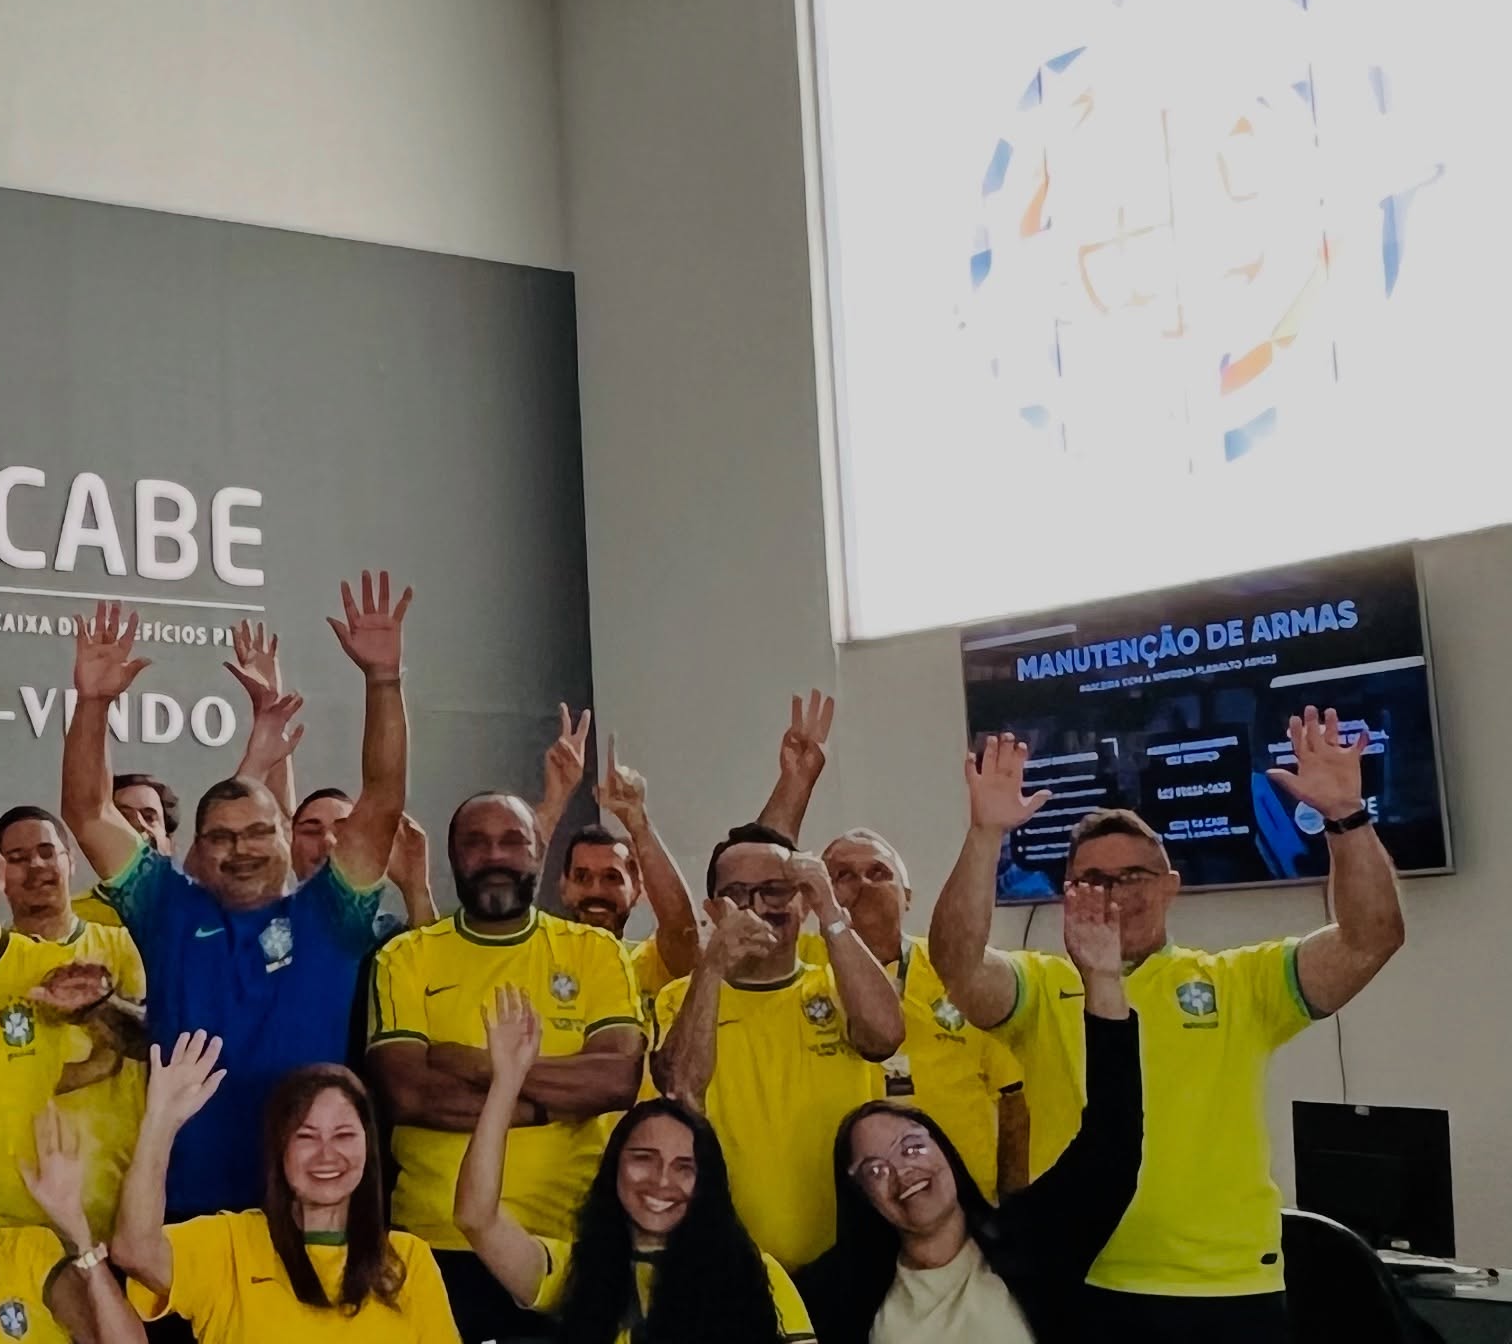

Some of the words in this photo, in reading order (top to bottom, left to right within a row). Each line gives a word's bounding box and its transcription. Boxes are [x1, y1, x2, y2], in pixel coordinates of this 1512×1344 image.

[1016, 624, 1200, 682] MANUTENÇÃO
[1205, 619, 1245, 651] DE
[1250, 599, 1359, 644] ARMAS
